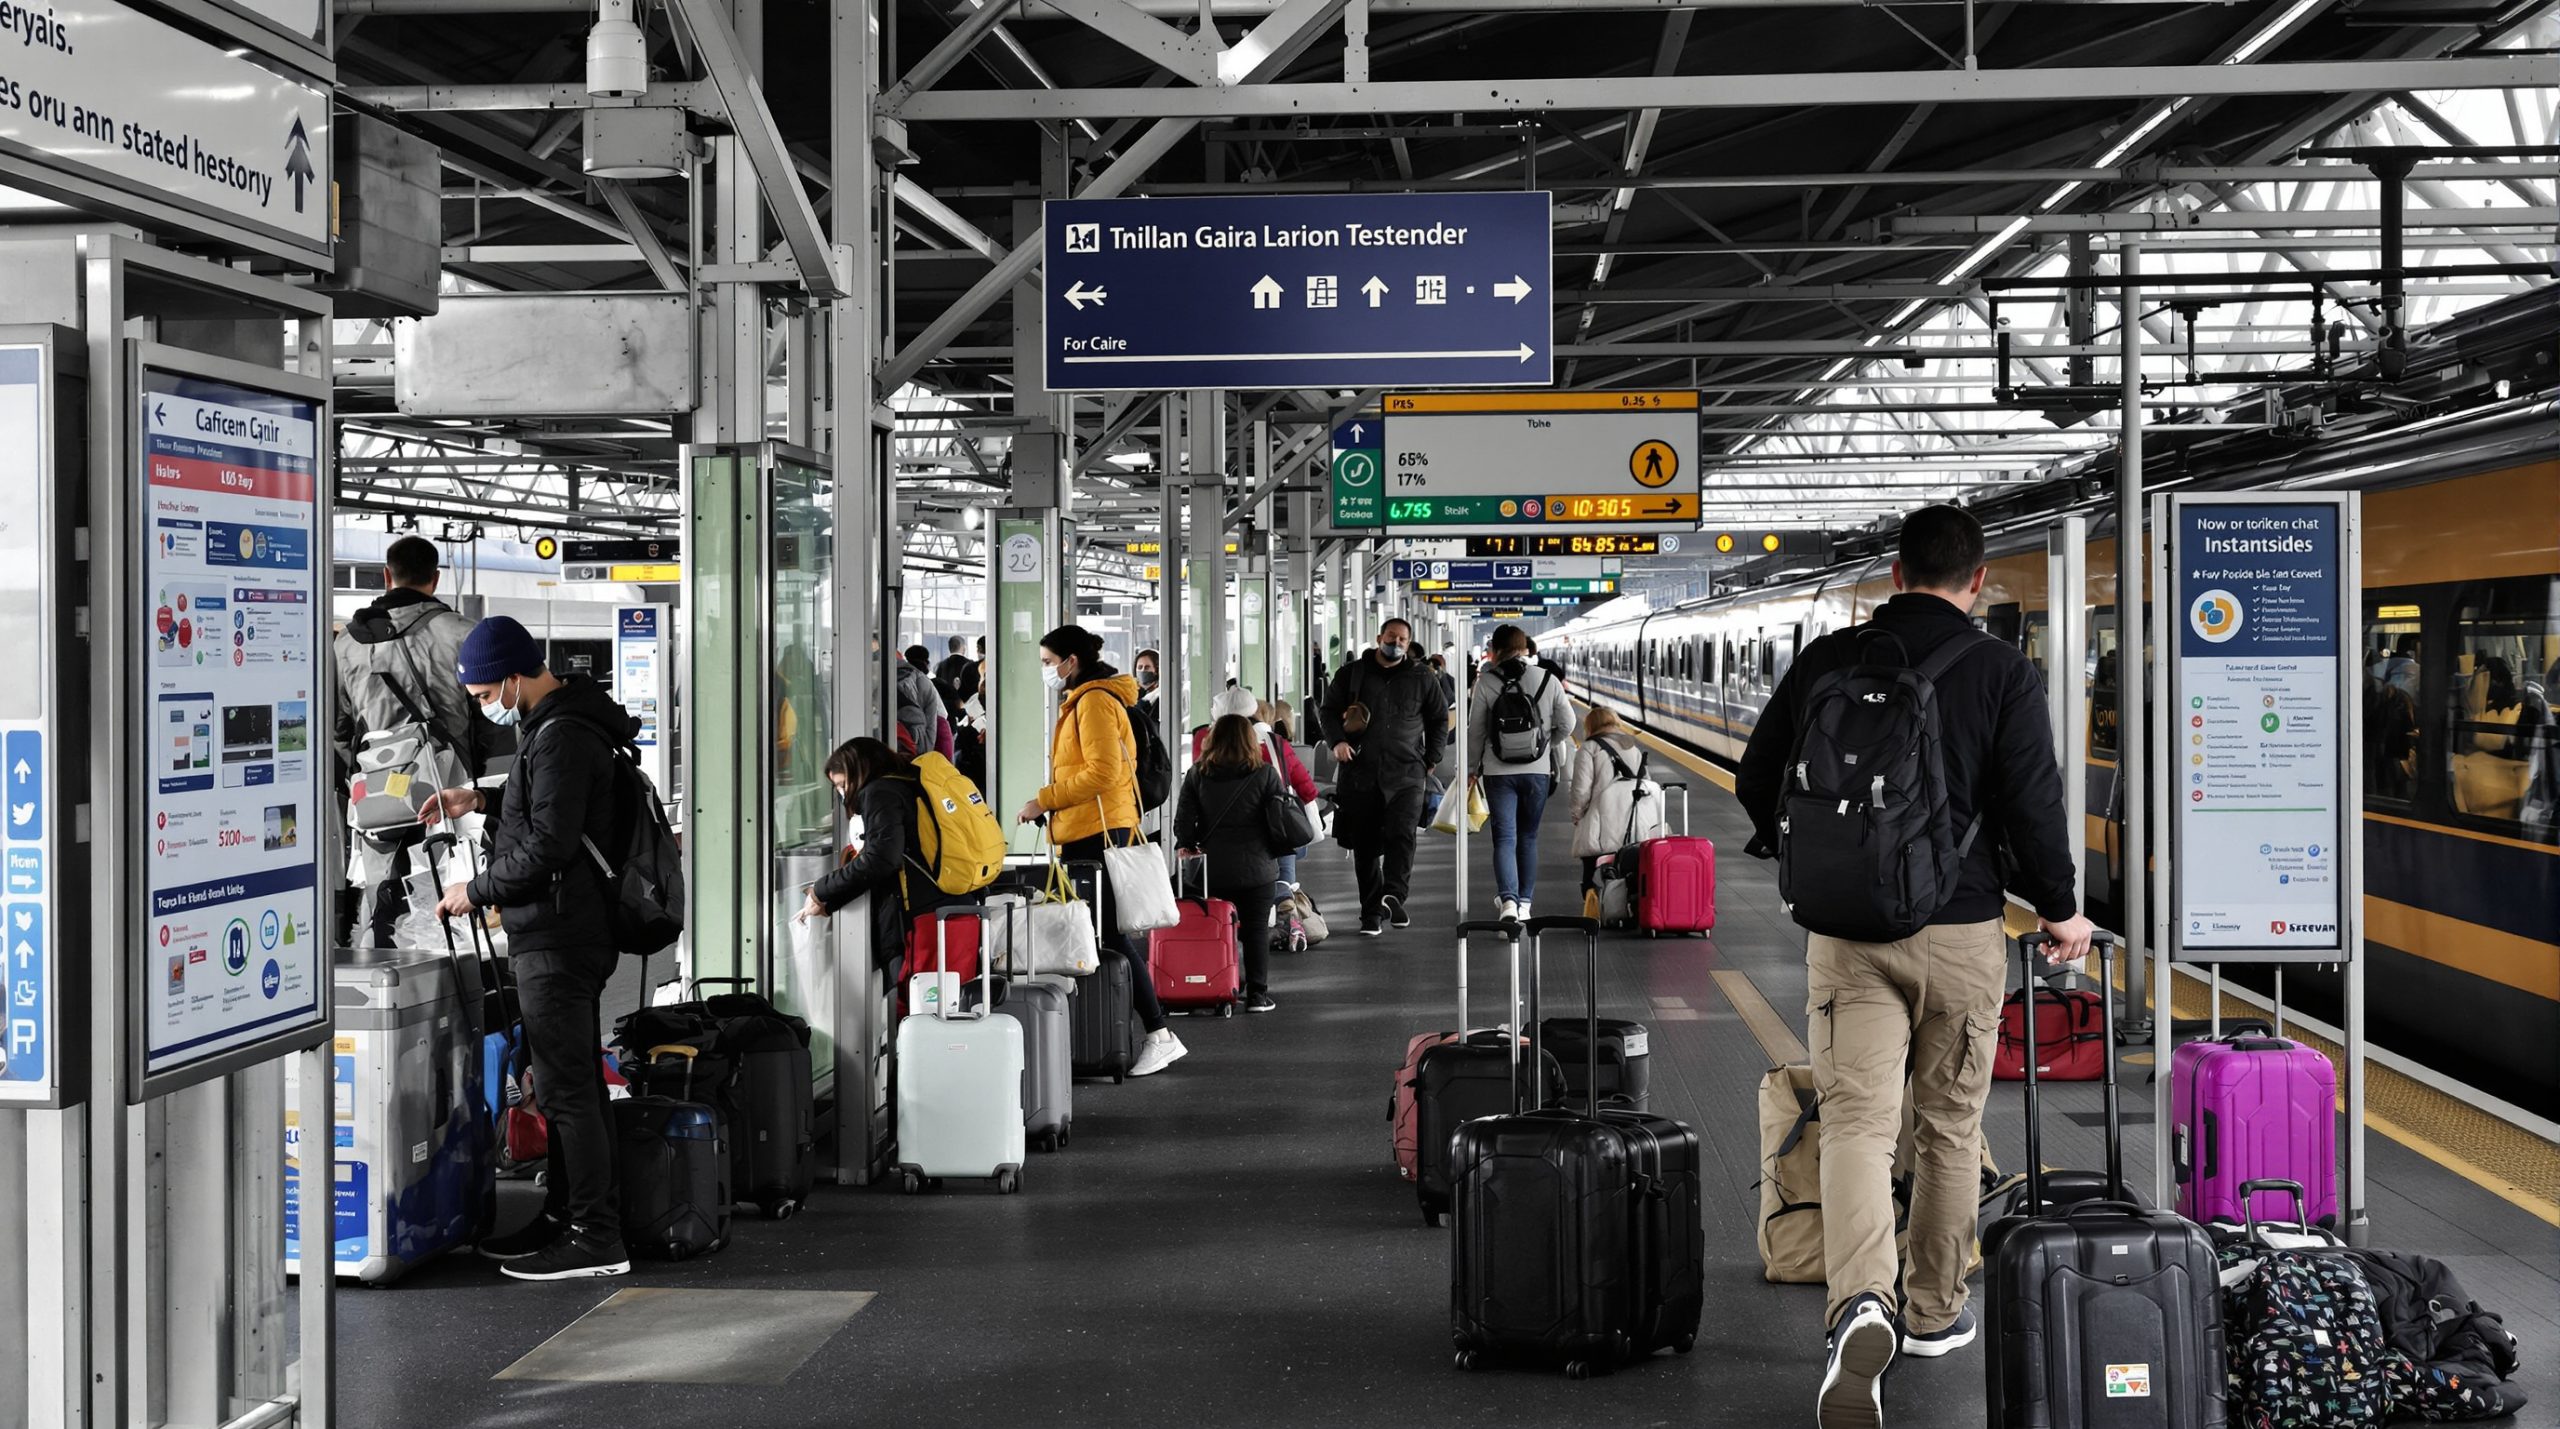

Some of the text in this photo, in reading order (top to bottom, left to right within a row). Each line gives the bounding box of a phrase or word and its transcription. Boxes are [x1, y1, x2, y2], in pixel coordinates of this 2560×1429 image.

[29, 90, 66, 128] oru
[73, 106, 114, 144] ann
[123, 122, 188, 170] stated
[1109, 222, 1468, 249] Tnillan Gaira Larion Testender
[1063, 336, 1127, 351] For Caire
[1397, 473, 1426, 486] 17%
[2197, 517, 2227, 530] Now
[2230, 519, 2243, 530] or
[2291, 517, 2320, 530] chat
[2205, 535, 2313, 553] Instantsides
